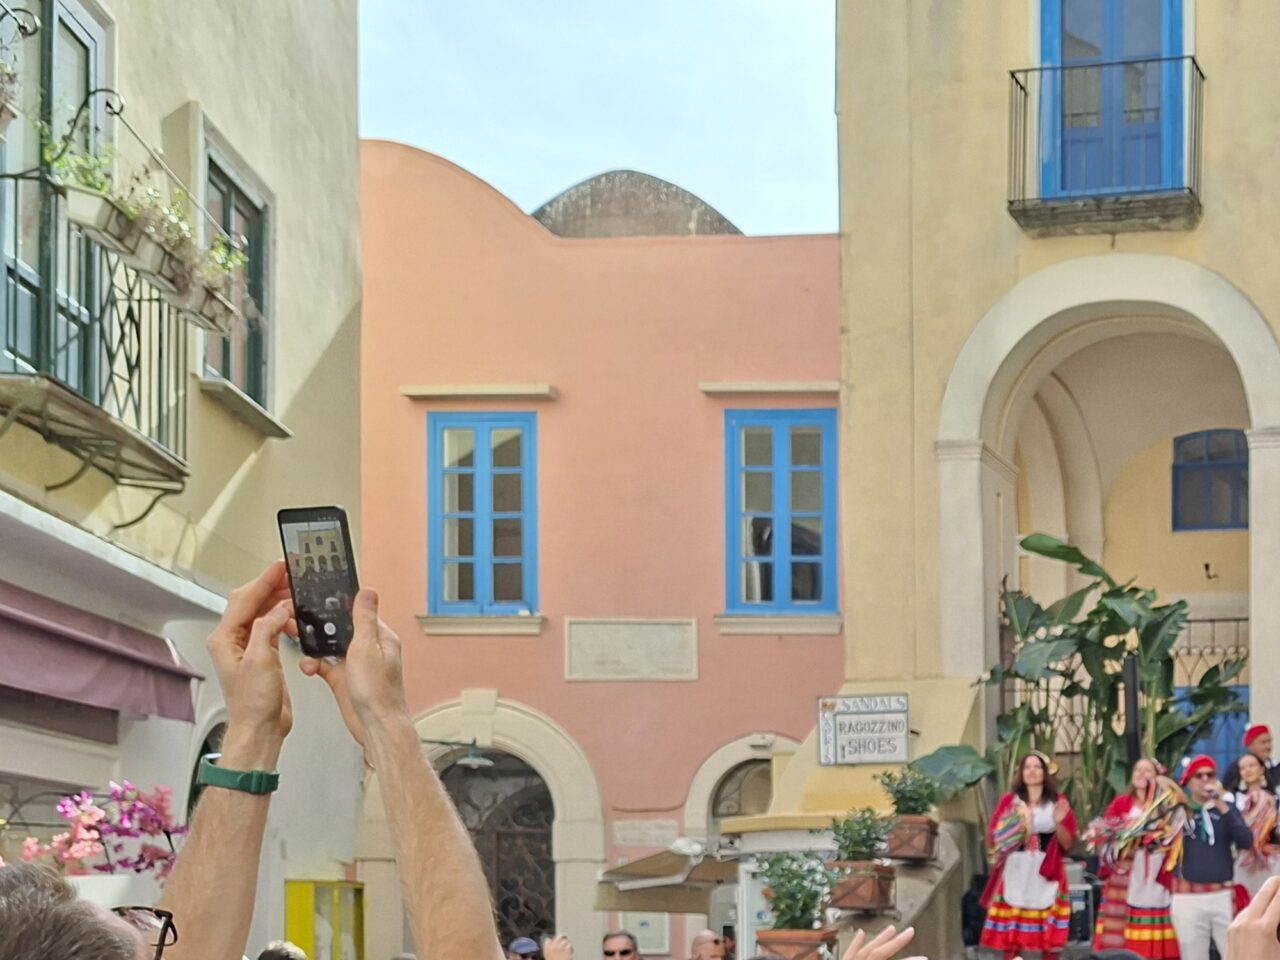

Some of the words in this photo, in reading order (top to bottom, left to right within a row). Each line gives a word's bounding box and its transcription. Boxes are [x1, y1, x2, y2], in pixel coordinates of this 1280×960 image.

[842, 697, 906, 711] SANDALS
[839, 720, 905, 735] RAGOZZINO
[848, 737, 897, 755] SHOES
